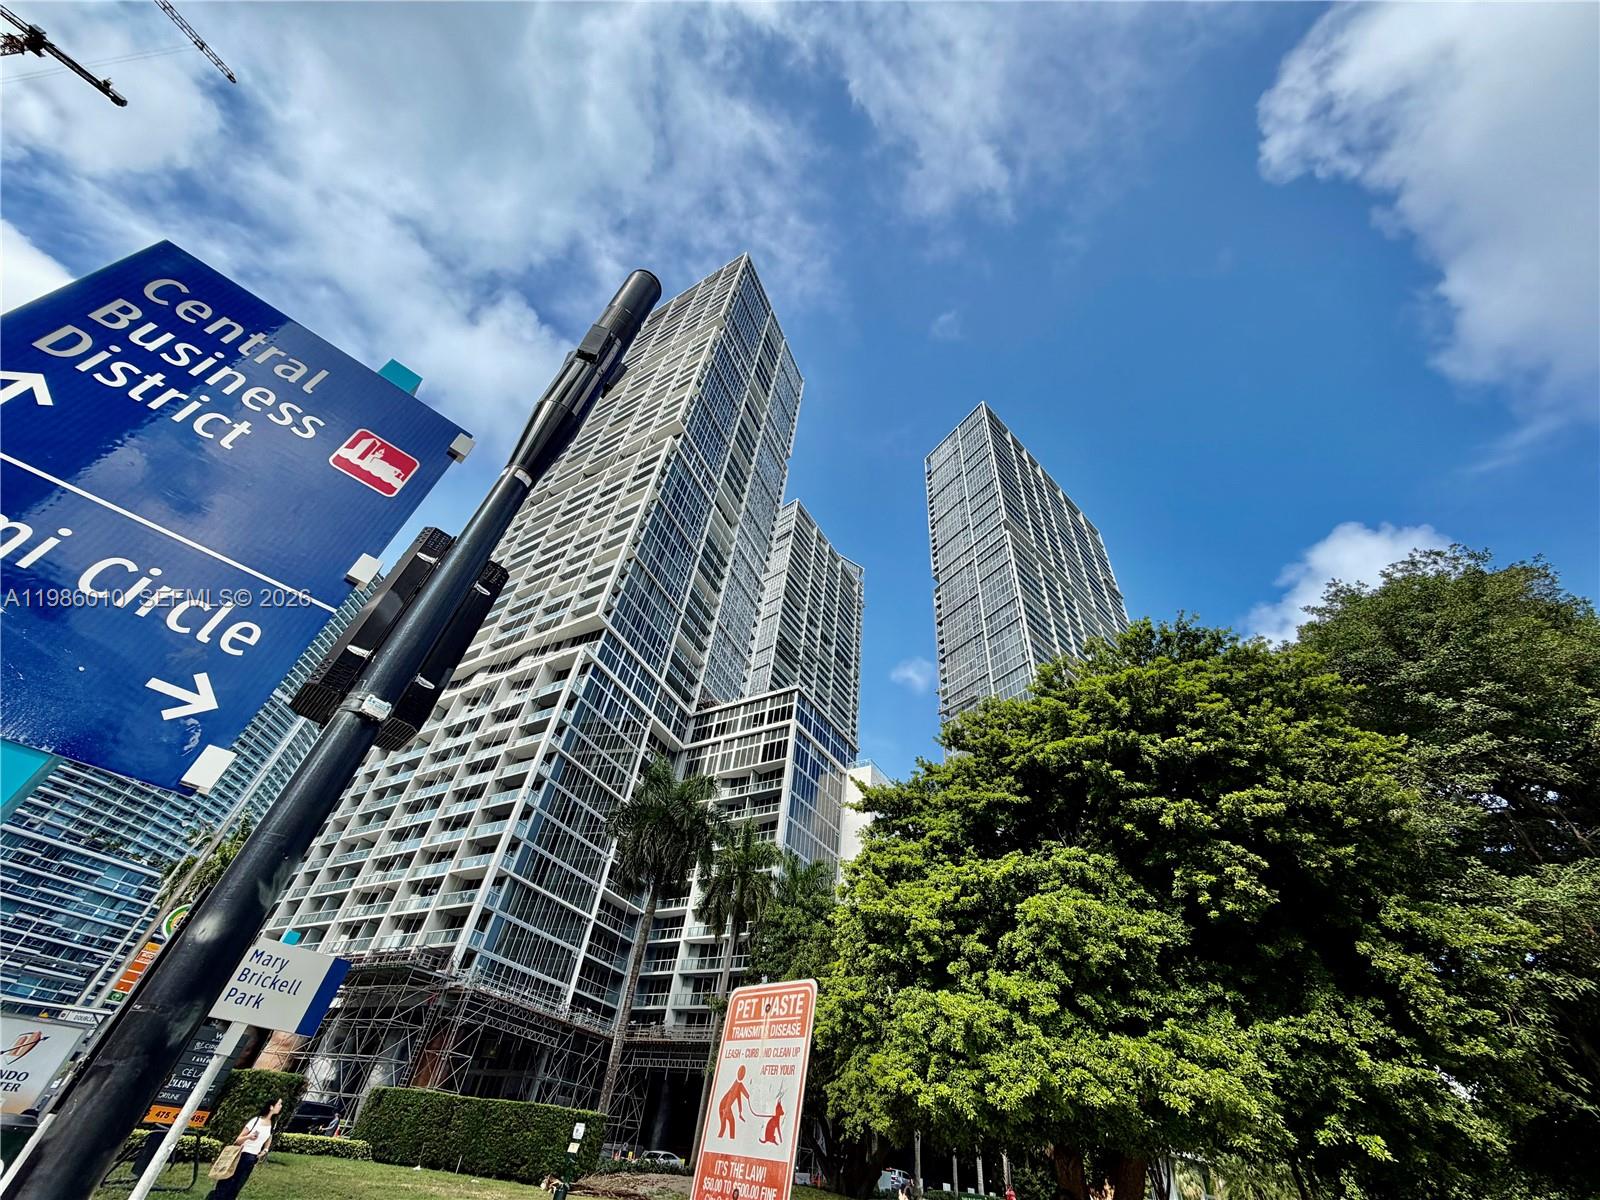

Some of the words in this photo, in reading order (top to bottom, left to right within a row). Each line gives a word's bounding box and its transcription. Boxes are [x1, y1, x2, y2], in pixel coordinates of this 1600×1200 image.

[144, 279, 329, 394] Central
[87, 299, 326, 439] Business
[32, 324, 252, 450] District
[78, 557, 262, 656] Circle
[249, 949, 290, 974] Mary
[237, 967, 302, 995] Brickell
[224, 987, 265, 1009] Park
[735, 998, 759, 1019] PET
[761, 993, 805, 1017] WASTE
[770, 1023, 802, 1037] DISEASE
[725, 1048, 741, 1059] LEASH
[745, 1048, 760, 1058] CURB
[772, 1047, 791, 1058] CLEAN
[792, 1047, 801, 1058] UP
[760, 1065, 779, 1075] AFTER
[780, 1065, 796, 1075] YOUR
[714, 1160, 728, 1176] IT'S
[729, 1162, 745, 1179] THE
[745, 1164, 767, 1183] LAW!
[703, 1176, 723, 1193] $50.00
[723, 1179, 732, 1194] TO
[760, 1186, 777, 1200] FINE
